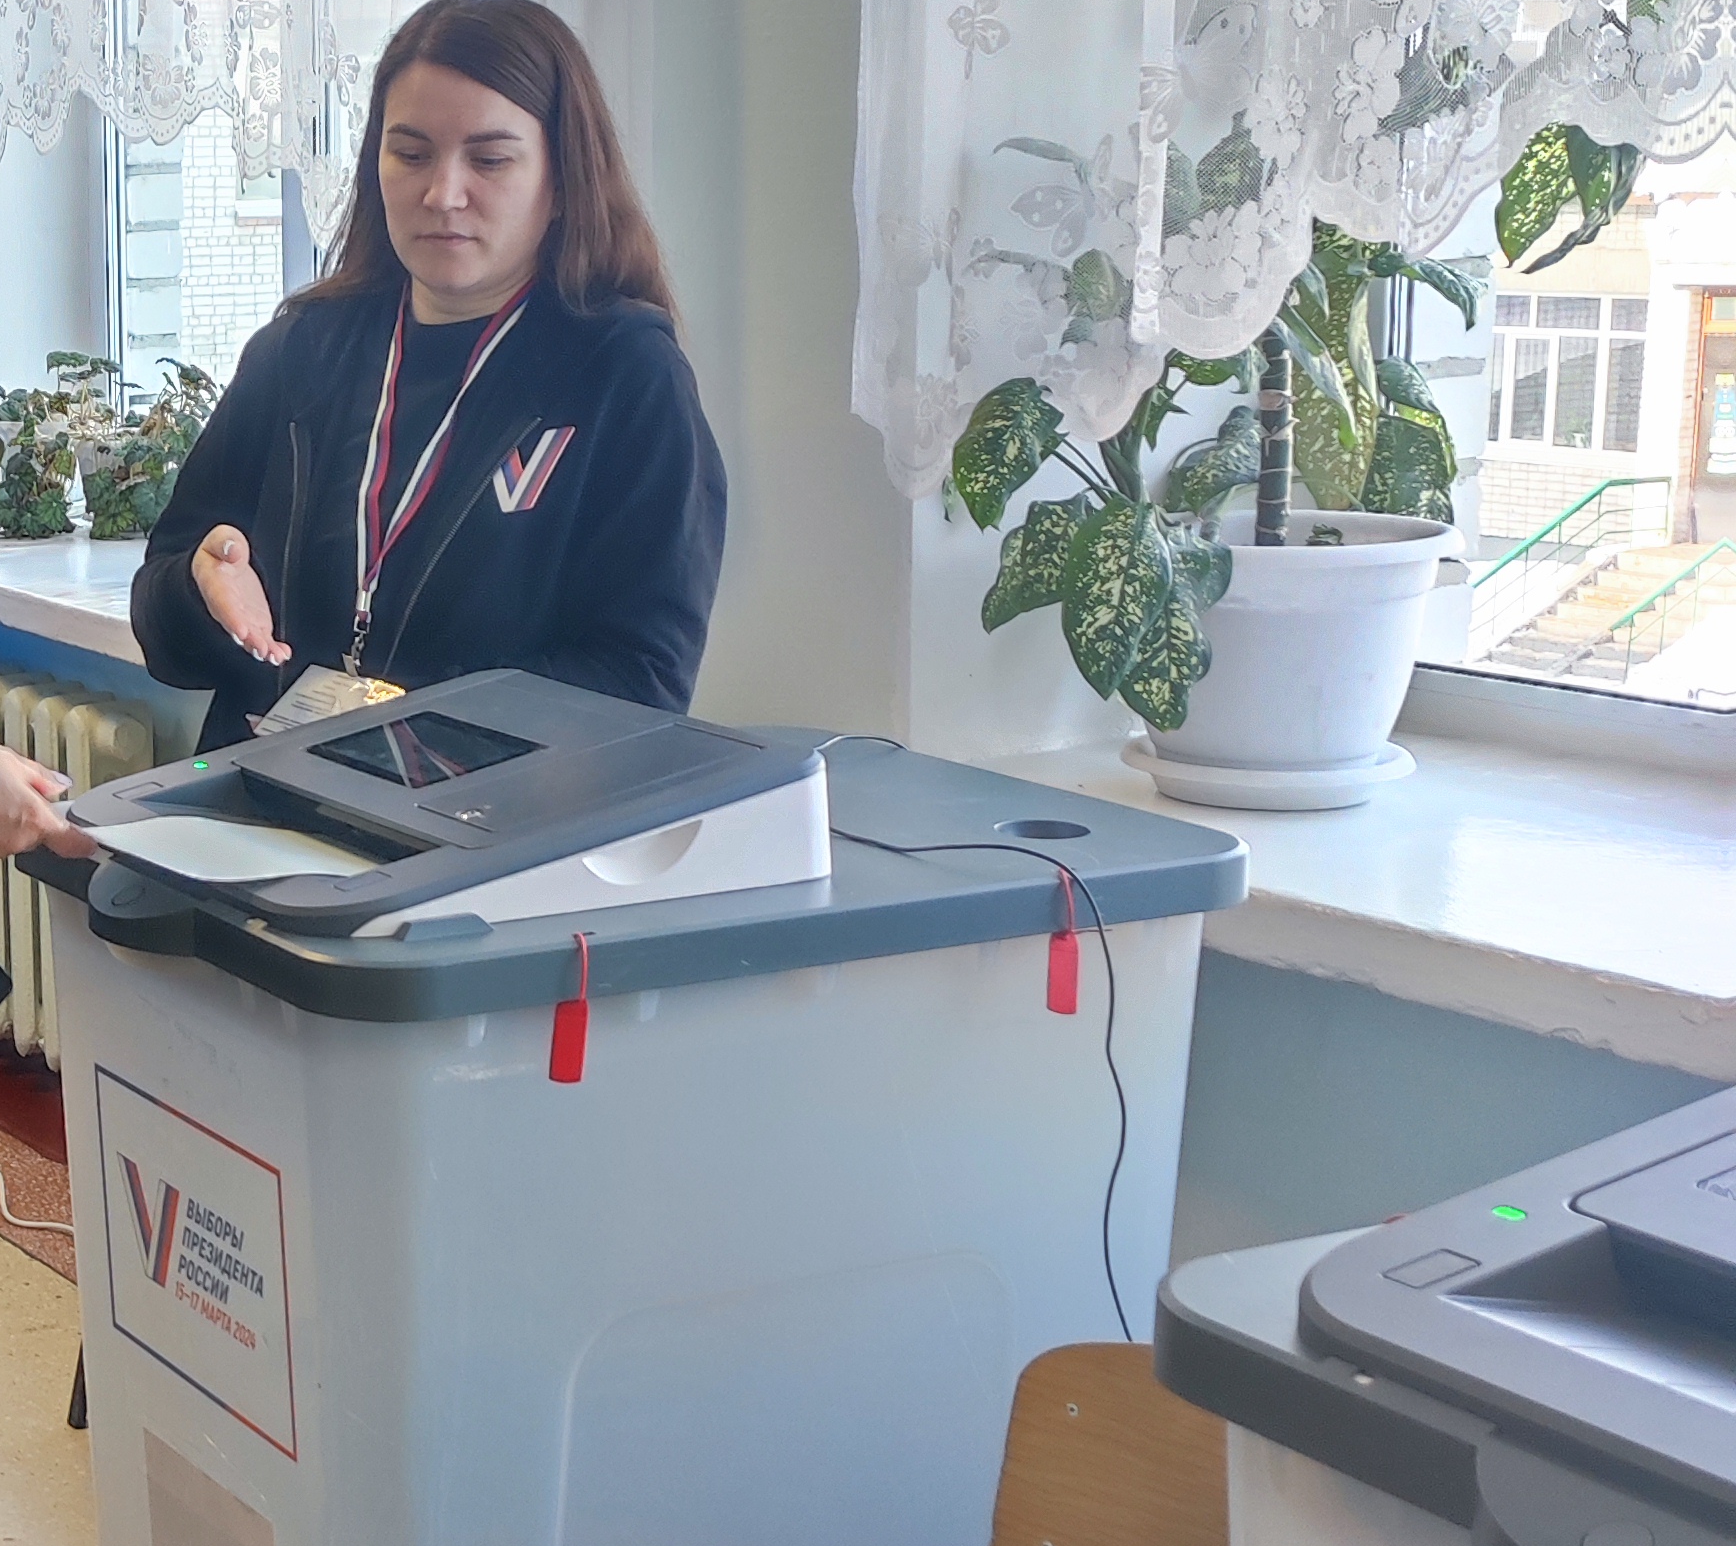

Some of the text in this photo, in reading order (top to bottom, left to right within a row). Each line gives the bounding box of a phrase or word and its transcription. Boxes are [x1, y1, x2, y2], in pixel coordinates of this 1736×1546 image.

[186, 1197, 244, 1252] ВЫБОРЫ
[178, 1254, 230, 1304] РОССИИ
[182, 1225, 264, 1298] ПРЕЗИДЕНТА
[200, 1300, 232, 1335] МАРТА
[233, 1321, 256, 1351] 2024
